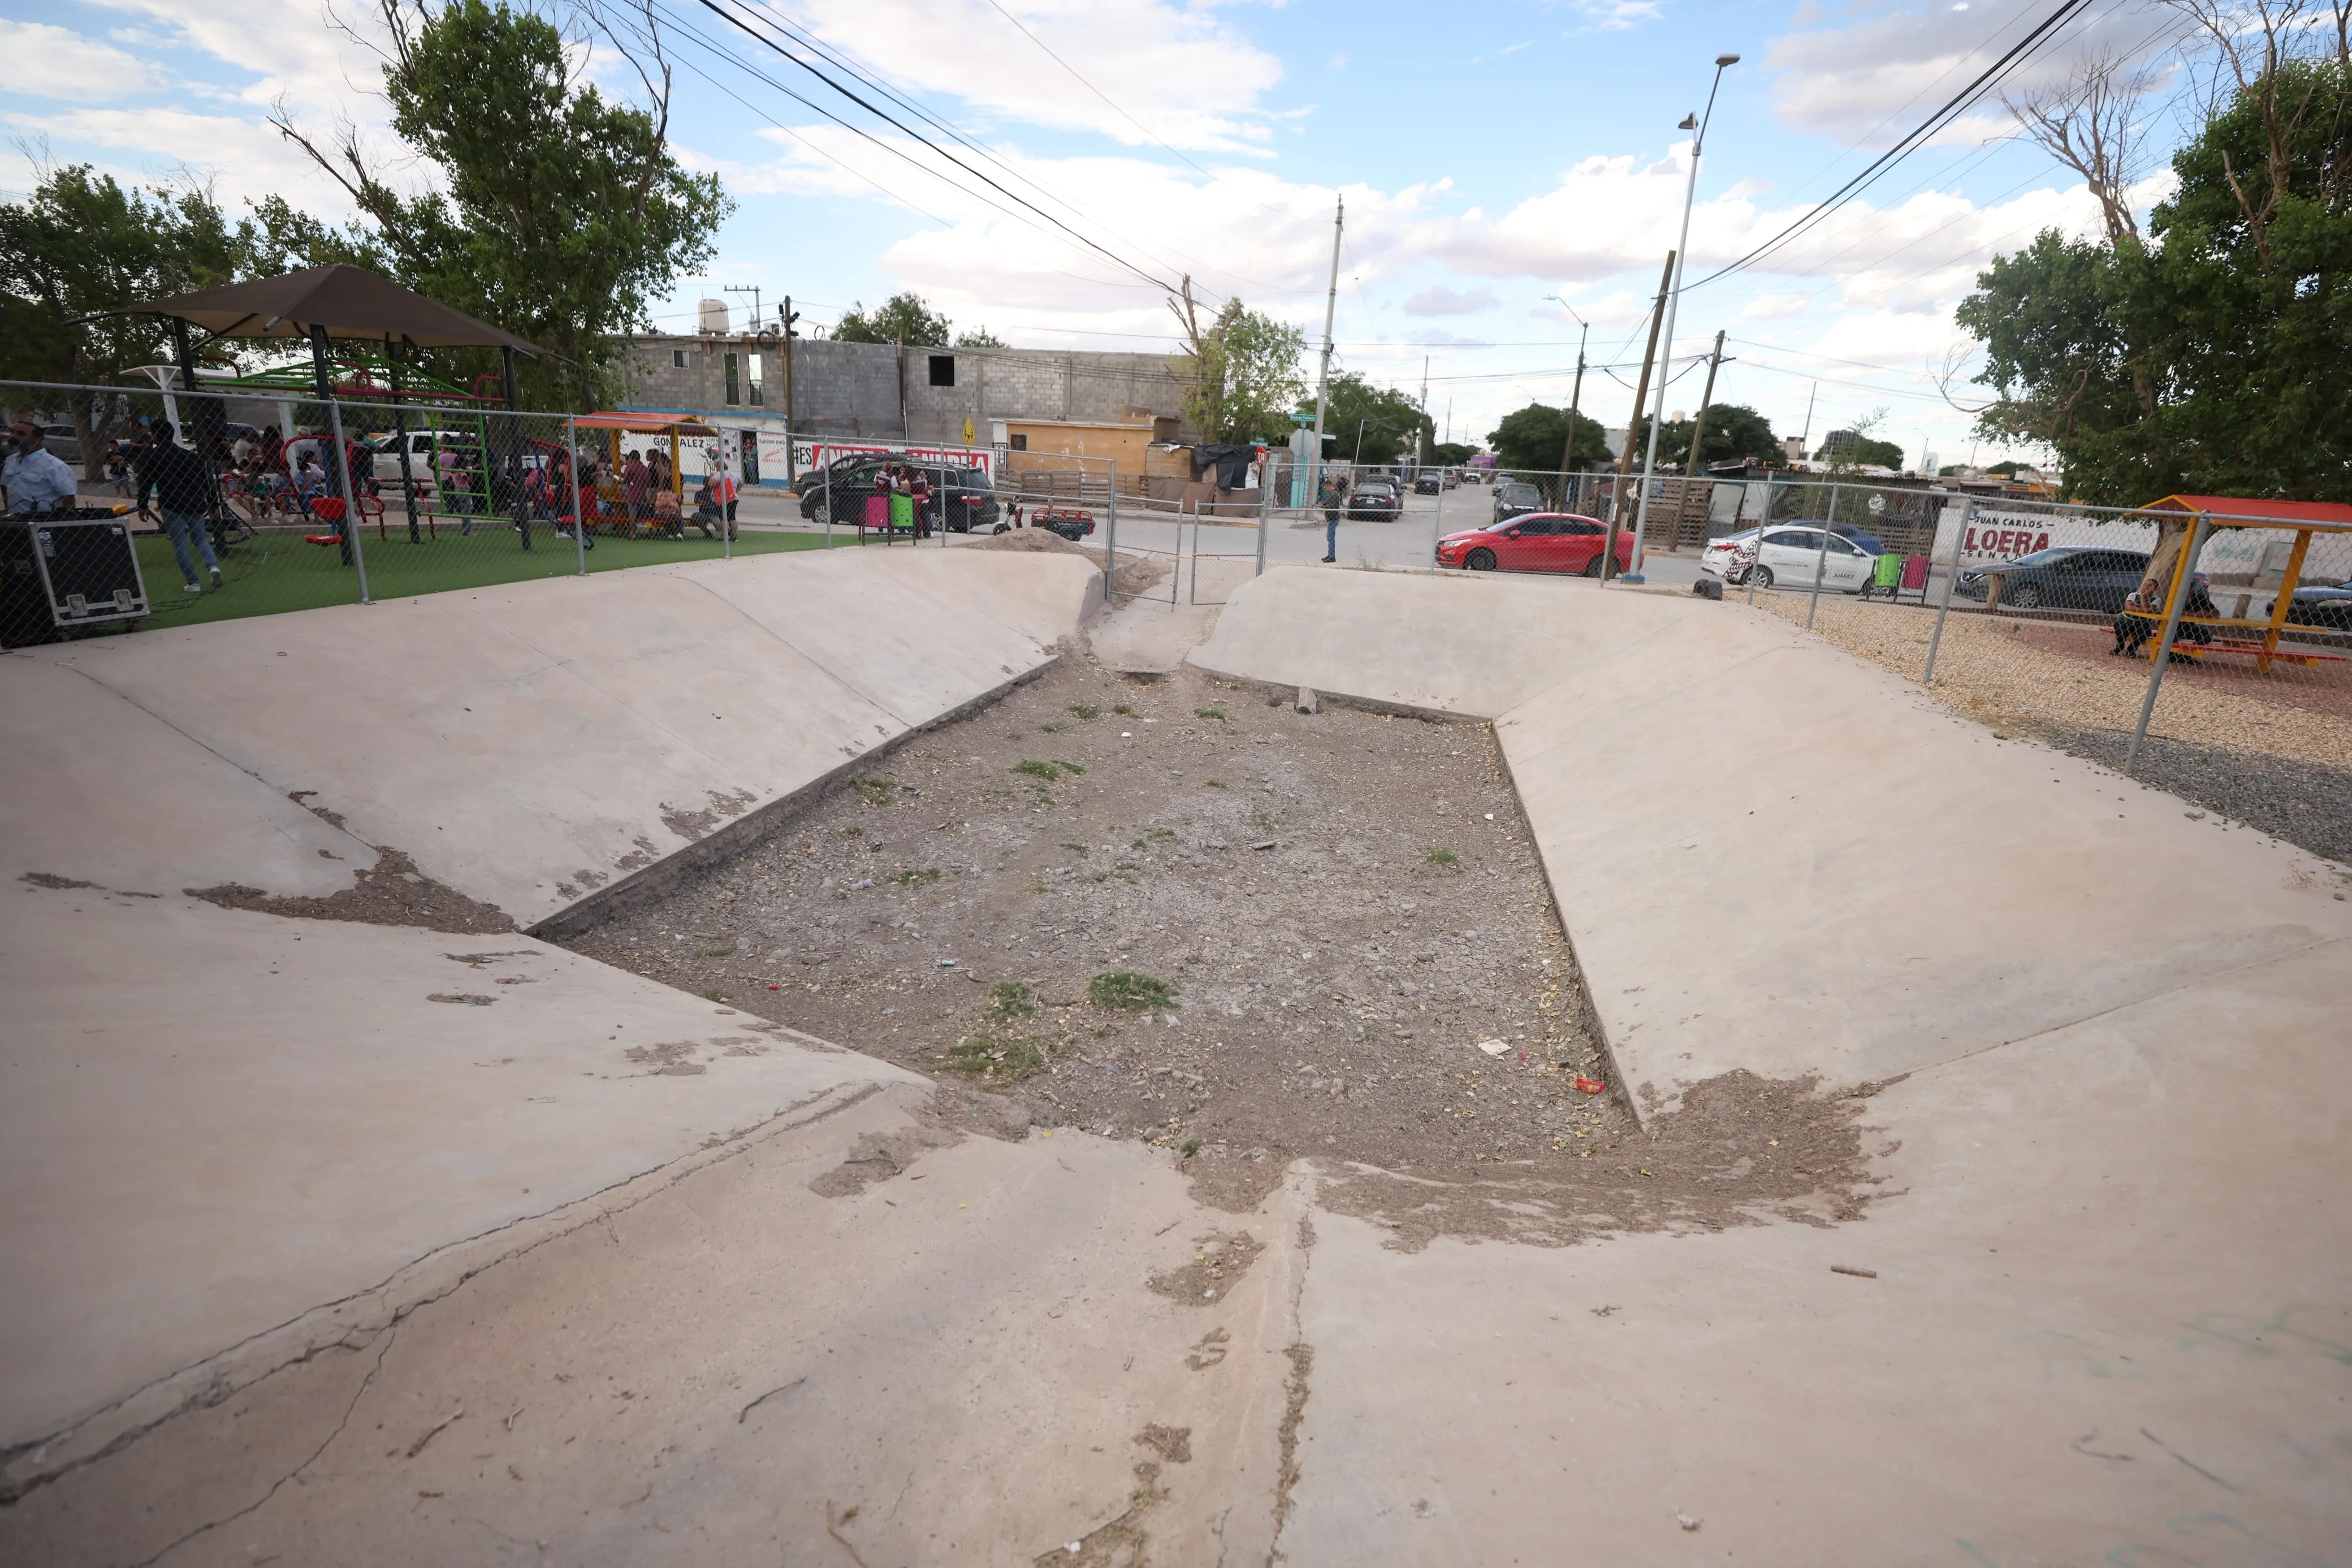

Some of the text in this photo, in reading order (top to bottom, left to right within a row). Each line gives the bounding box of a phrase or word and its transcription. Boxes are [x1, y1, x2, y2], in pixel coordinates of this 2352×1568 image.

[654, 437, 704, 448] GONALEZ
[1975, 516, 2043, 528] JUAN CARLOS
[1964, 527, 2049, 554] LOERA
[1967, 550, 2022, 561] SENAD
